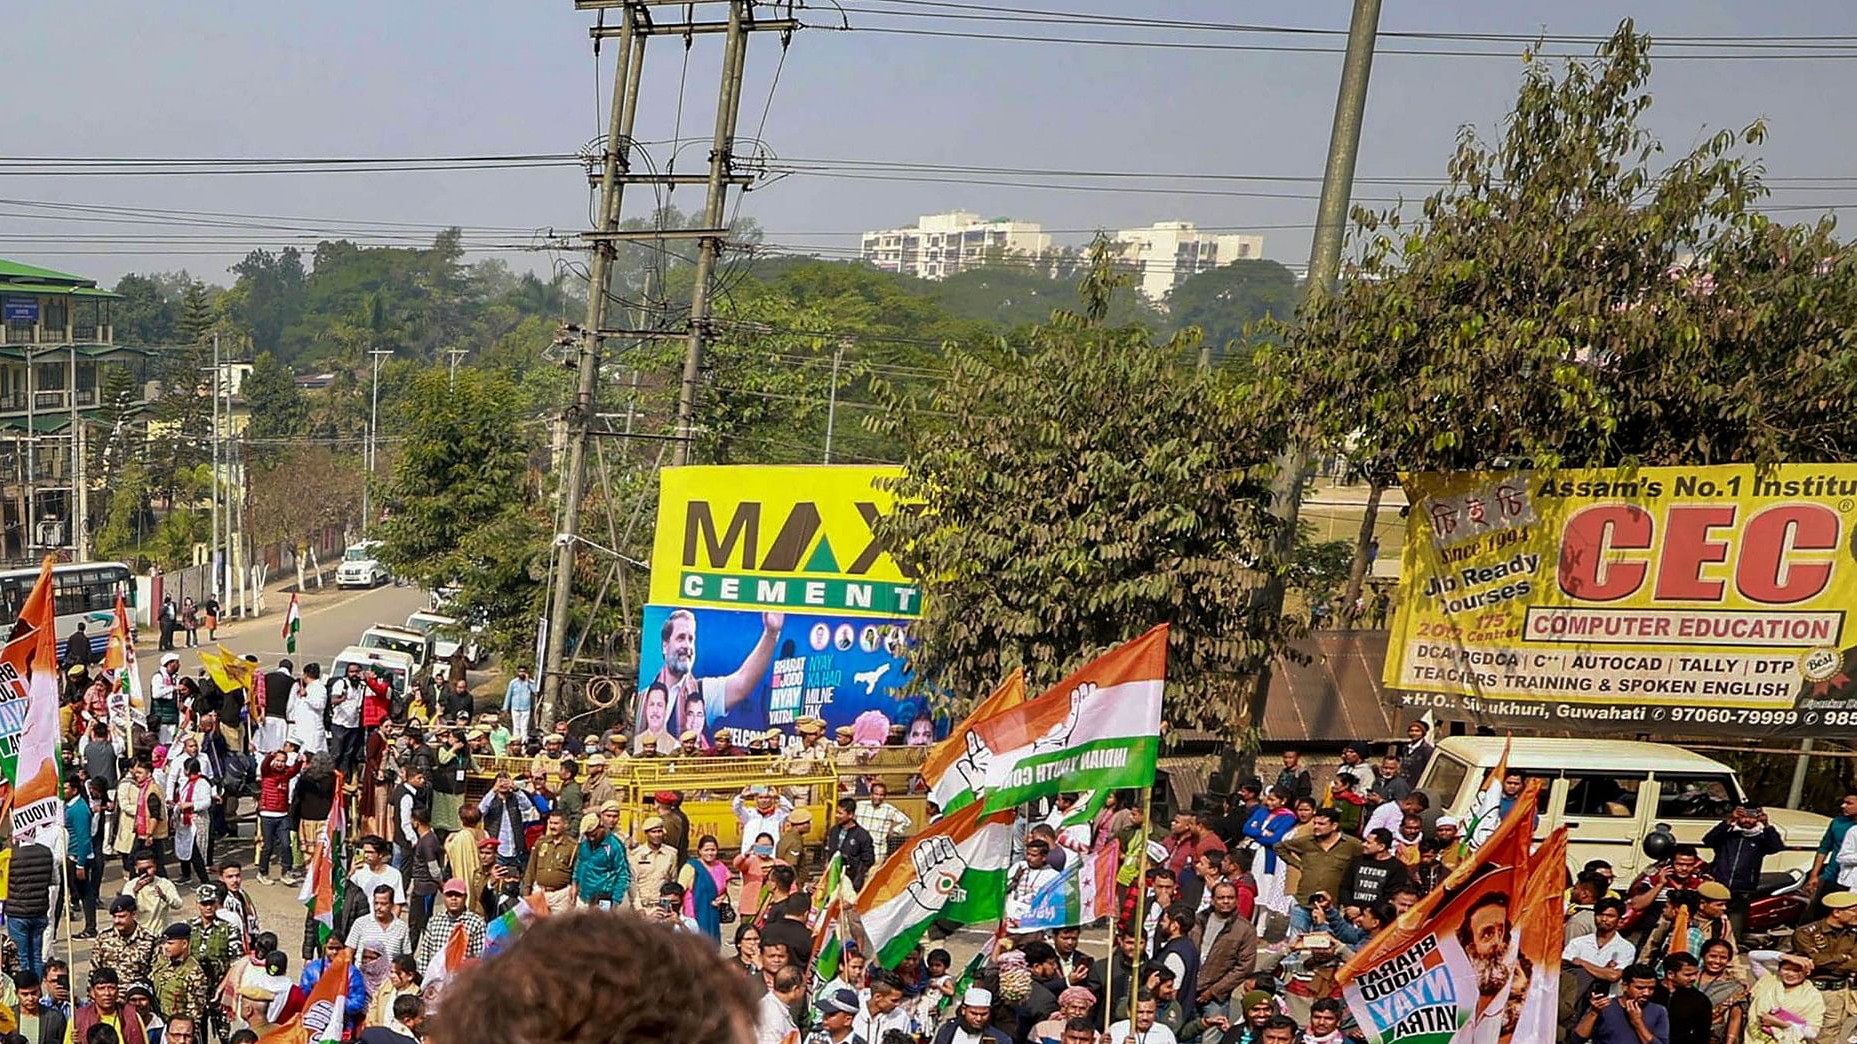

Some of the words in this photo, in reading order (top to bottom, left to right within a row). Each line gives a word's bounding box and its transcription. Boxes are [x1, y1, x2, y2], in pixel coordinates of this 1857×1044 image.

[1537, 477, 1662, 498] Assam's
[1674, 476, 1742, 498] No.1
[682, 500, 928, 578] MAX
[1488, 526, 1530, 553] 1994
[1557, 503, 1841, 604] CEC
[1425, 575, 1457, 597] Jb
[1462, 553, 1540, 587] Ready
[684, 575, 916, 611] CEMENT
[1443, 580, 1531, 615] ourses
[1533, 615, 1670, 638] COMPUTER
[1678, 617, 1830, 640] EDUCATION
[1417, 645, 1451, 659] DCA
[1461, 650, 1519, 667] PGDCA
[1572, 656, 1662, 671] AUTOCAD
[1679, 658, 1738, 673] TALLY
[1755, 660, 1794, 674] DTP
[780, 672, 804, 687] JODO
[1413, 666, 1498, 687] TEACERS
[1504, 675, 1592, 691] TRAINING
[1598, 678, 1611, 692] &
[1618, 679, 1697, 694] SPOKEN
[1702, 681, 1790, 697] ENGLISH
[771, 687, 801, 709] NYAY
[805, 687, 835, 704] MILNE
[805, 705, 822, 719] TAK
[1463, 697, 1551, 719] Silukhuri,
[1556, 704, 1646, 721] Guwahati
[1670, 707, 1798, 726] 97060-79999
[1358, 866, 1388, 878] BEYOND
[1359, 880, 1379, 889] YOUR
[1353, 891, 1378, 902] LIMITS
